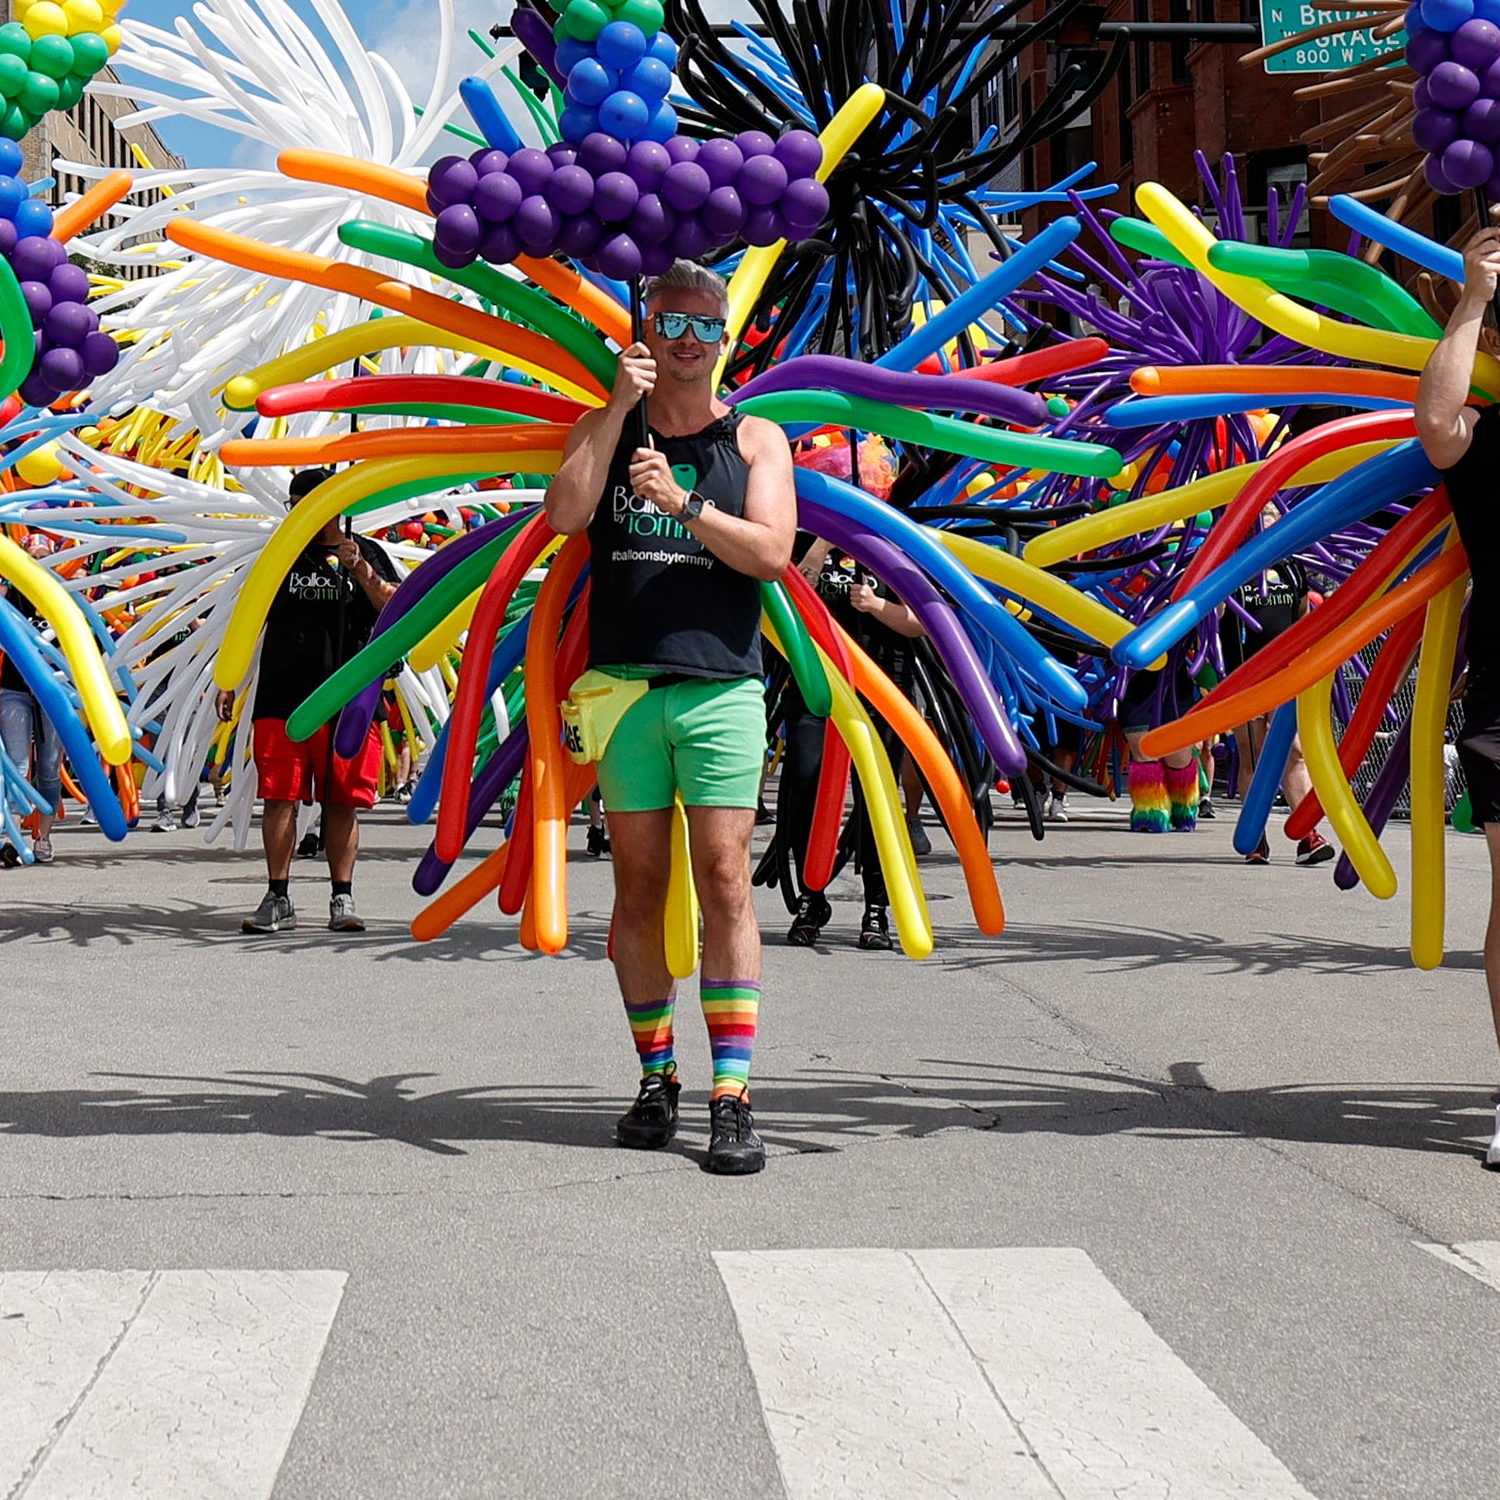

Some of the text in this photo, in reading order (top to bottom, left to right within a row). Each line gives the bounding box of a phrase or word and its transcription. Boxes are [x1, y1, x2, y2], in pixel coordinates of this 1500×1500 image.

[1272, 9, 1283, 23] N
[1296, 48, 1354, 64] 800 W
[613, 512, 626, 525] by
[611, 549, 715, 570] #balloonsbytommy
